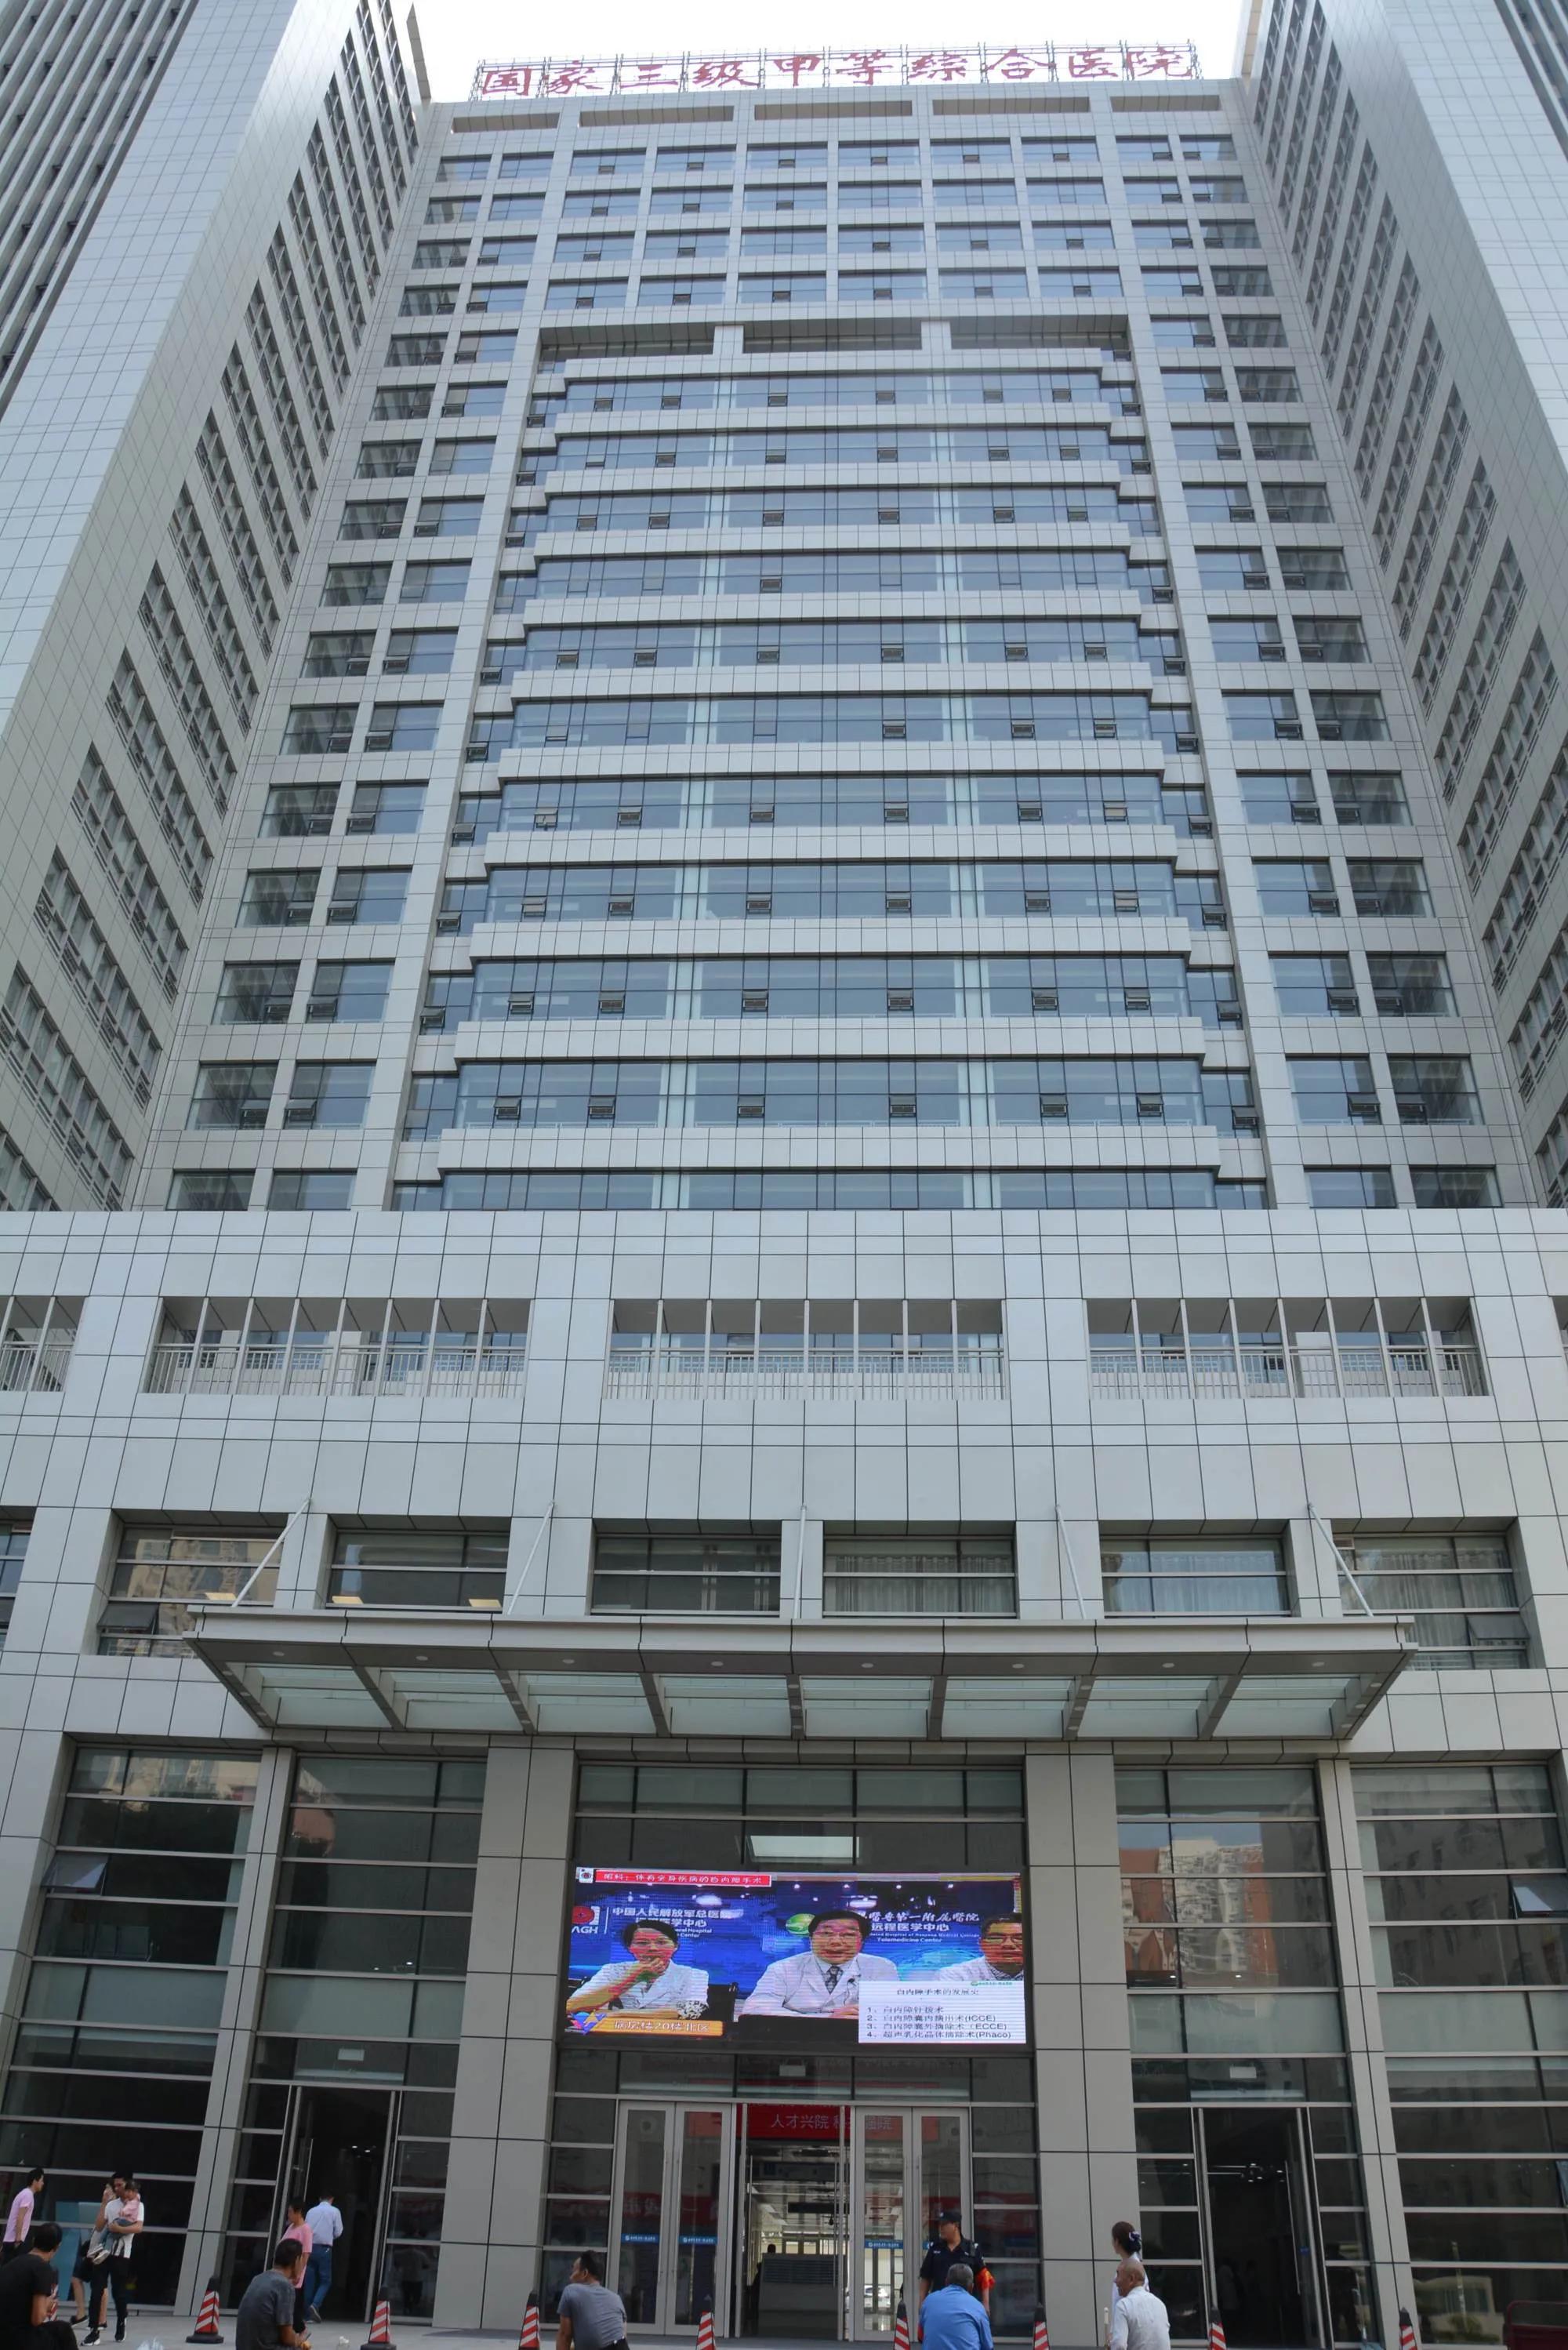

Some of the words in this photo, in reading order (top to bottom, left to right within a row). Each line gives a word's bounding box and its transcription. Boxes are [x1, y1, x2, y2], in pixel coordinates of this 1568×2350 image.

[481, 45, 1192, 96] 国家三级甲等综合医院
[771, 2113, 829, 2130] 人才兴院
